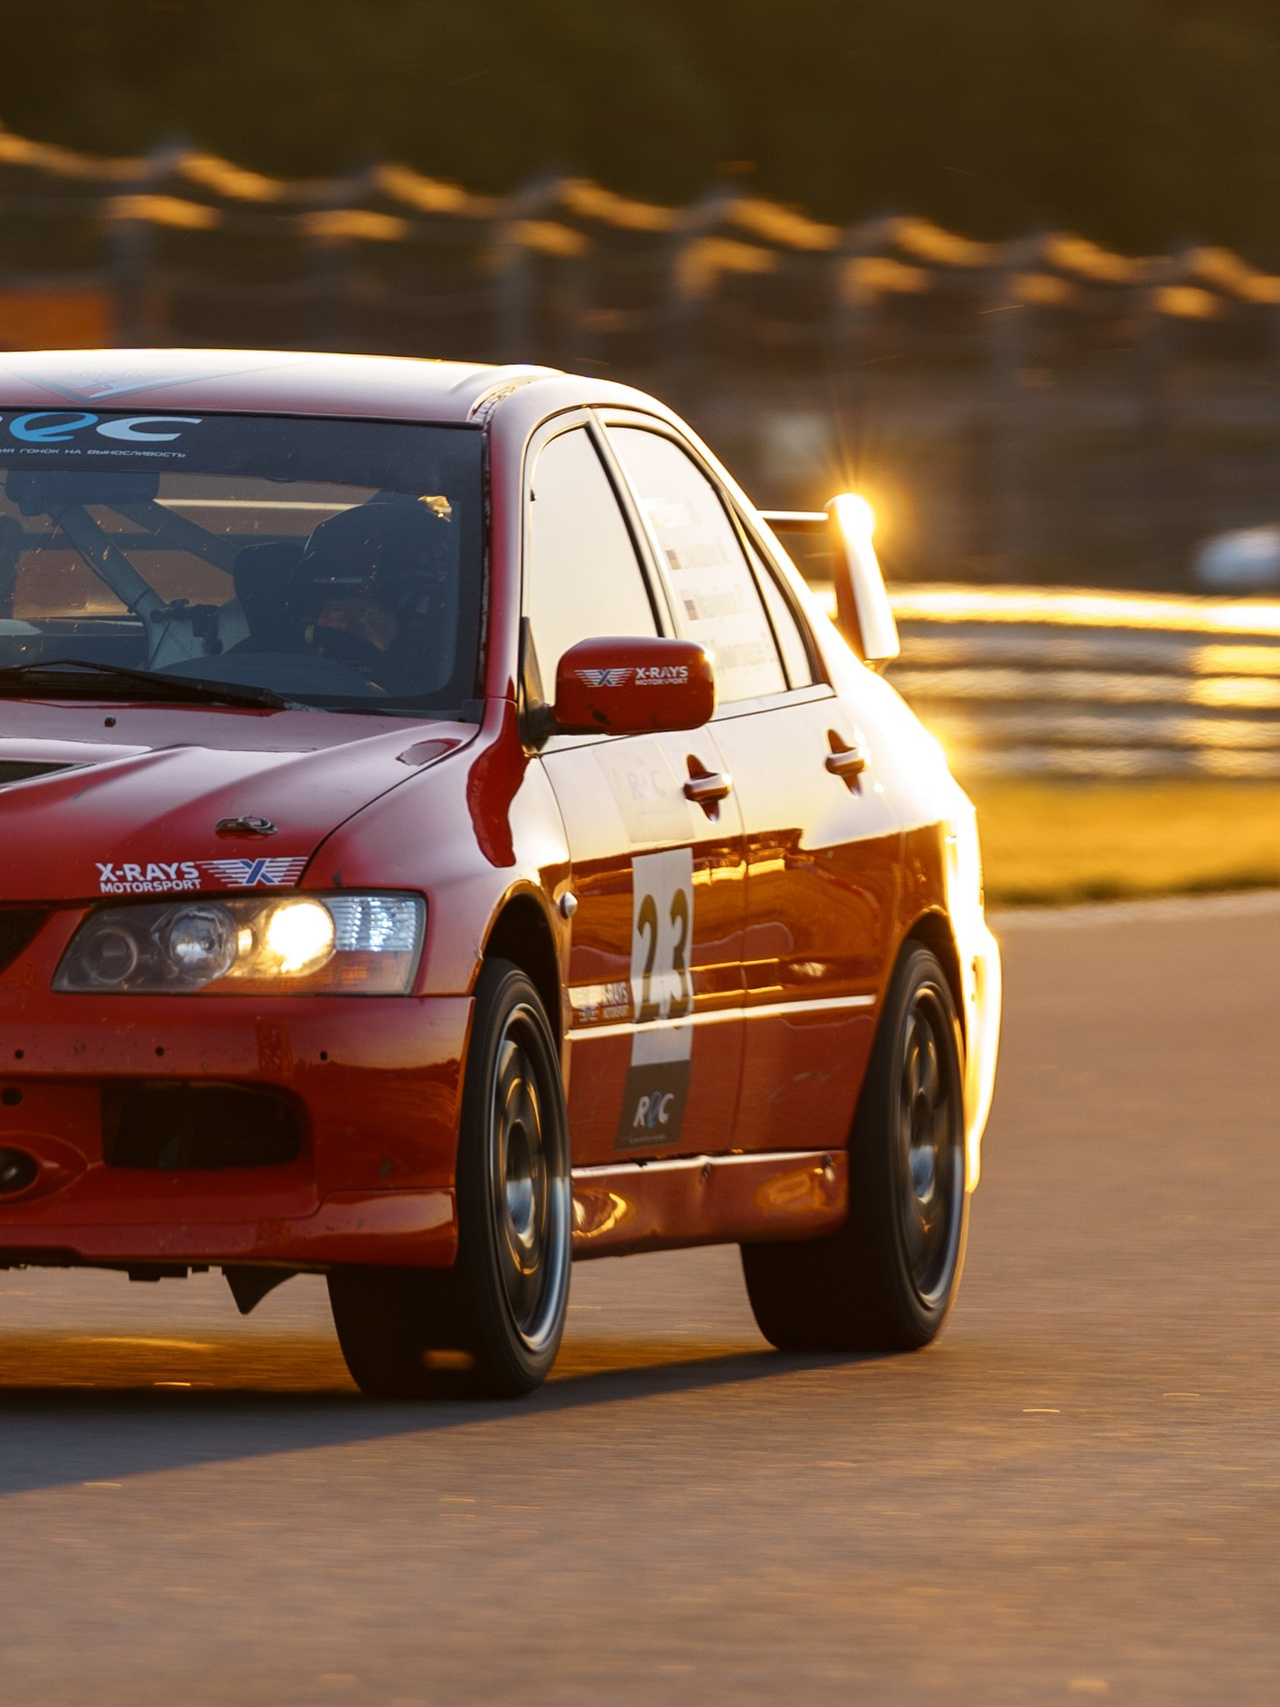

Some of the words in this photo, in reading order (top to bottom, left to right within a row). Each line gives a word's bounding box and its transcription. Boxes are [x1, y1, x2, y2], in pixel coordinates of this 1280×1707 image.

[87, 449, 186, 458] ВЫНОСЛИВОСТЬ
[635, 665, 688, 679] X-RAYS
[635, 677, 688, 686] MOTORSPORT
[95, 861, 199, 882] X-RAYS
[99, 878, 202, 894] MOTORSPORT
[633, 887, 688, 1030] 23
